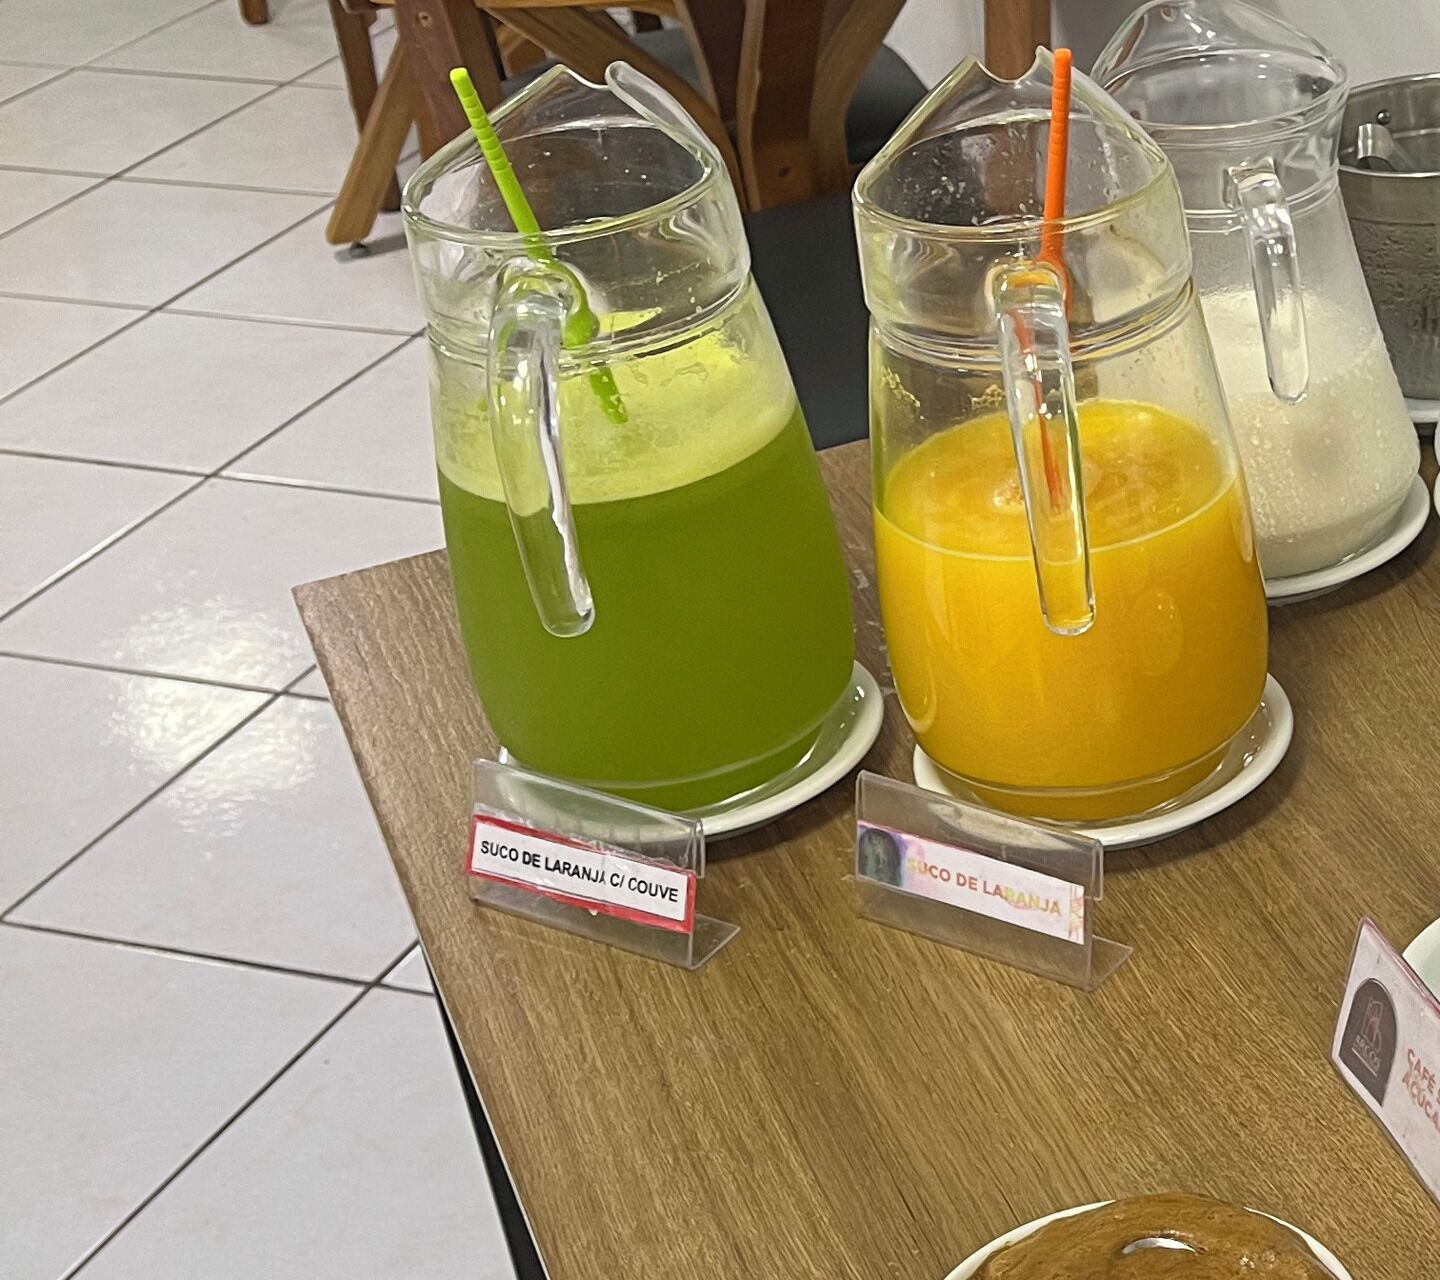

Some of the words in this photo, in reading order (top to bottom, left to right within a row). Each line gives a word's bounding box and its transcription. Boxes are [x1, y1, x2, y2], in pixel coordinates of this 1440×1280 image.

[480, 840, 519, 862] SUCO
[522, 851, 541, 868] DE
[545, 857, 606, 884] LARANJA
[610, 873, 626, 888] C/
[628, 877, 679, 902] COUVE
[907, 858, 951, 882] SUCO
[956, 872, 978, 891] DE
[983, 880, 1062, 917] LARANJA
[1408, 1048, 1436, 1096] CAFÉ
